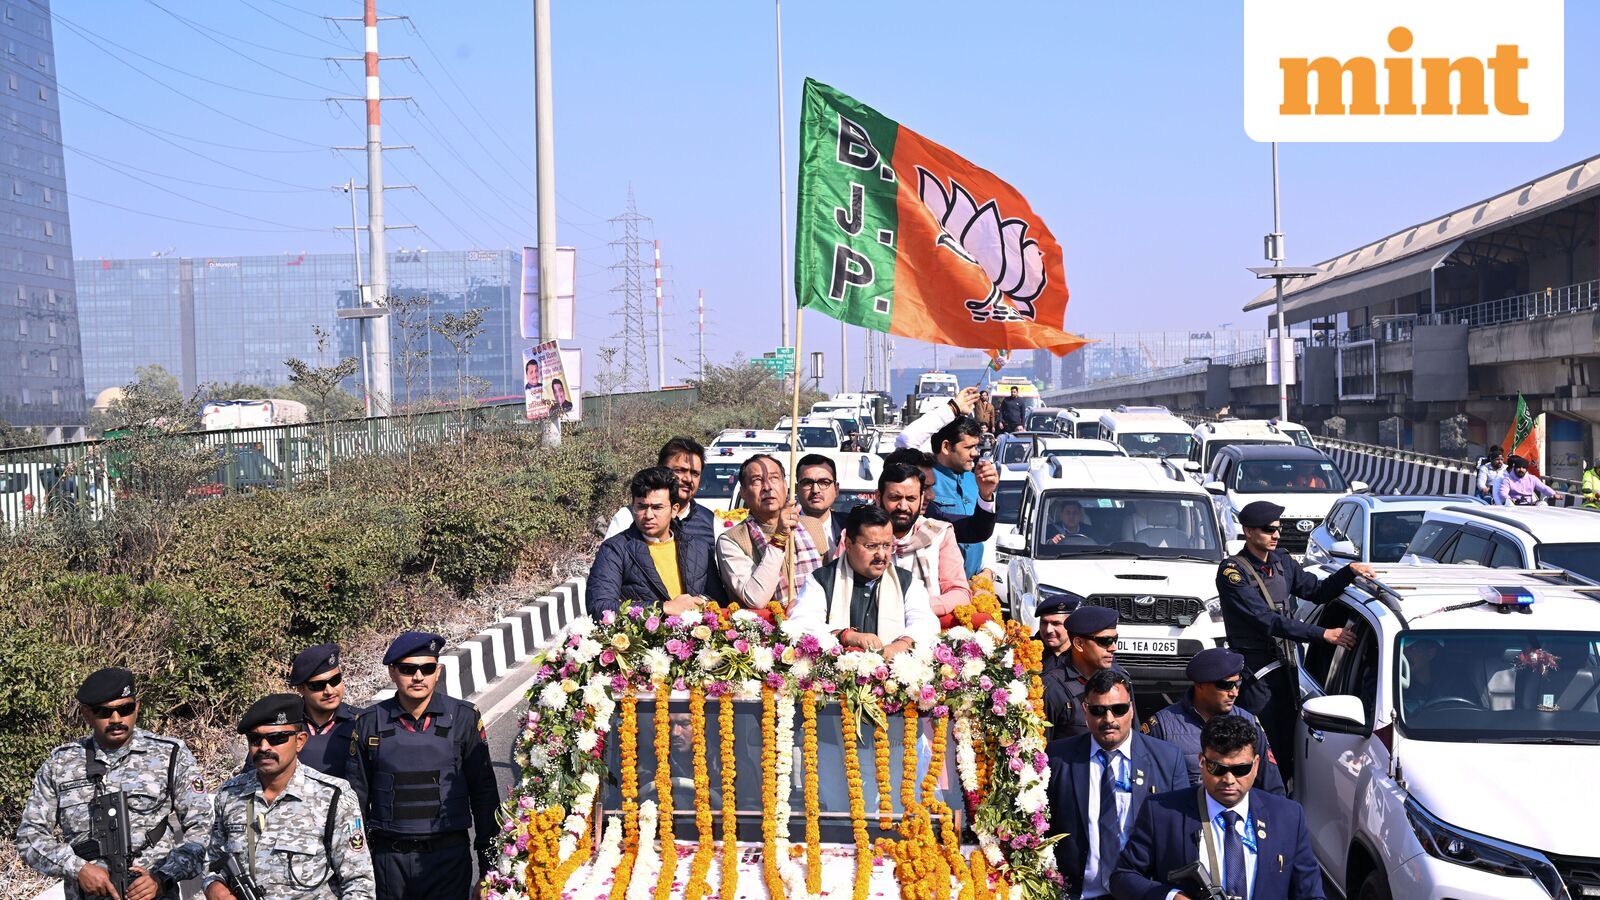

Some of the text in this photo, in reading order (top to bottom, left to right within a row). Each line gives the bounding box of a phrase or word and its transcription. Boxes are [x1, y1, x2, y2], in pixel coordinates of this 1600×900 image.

[1117, 641, 1176, 652] DL 1EA 0265
